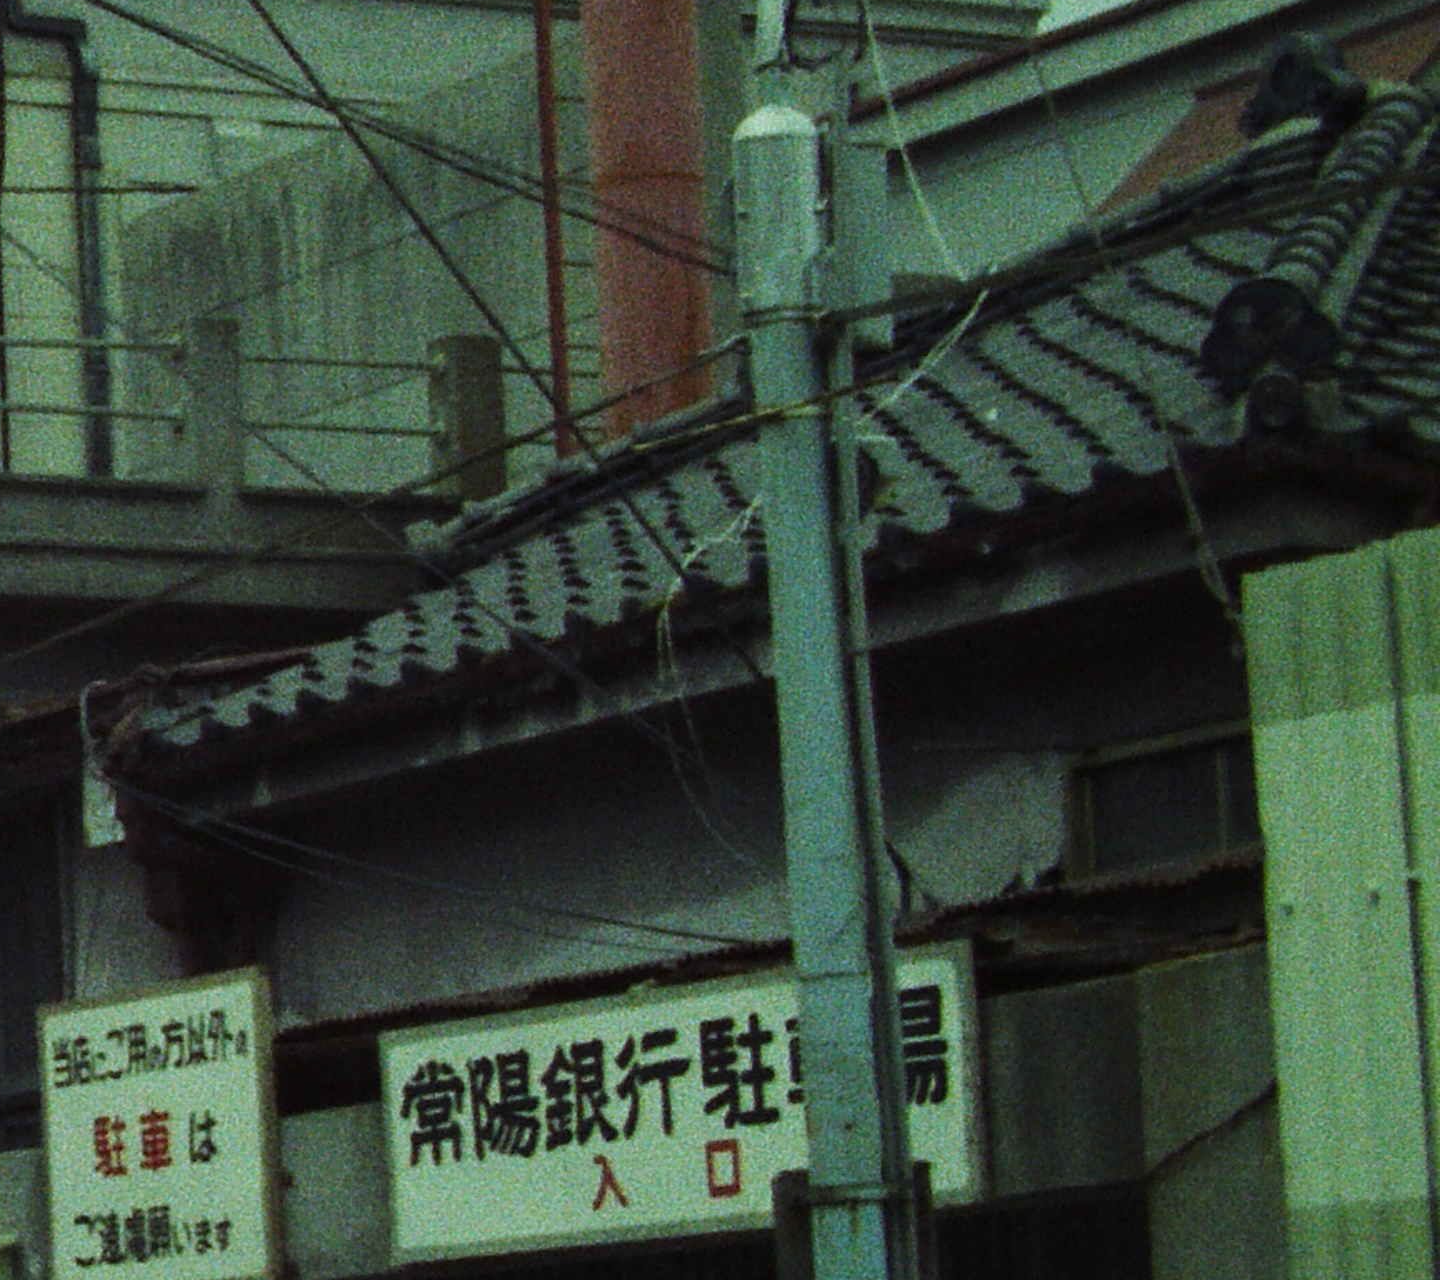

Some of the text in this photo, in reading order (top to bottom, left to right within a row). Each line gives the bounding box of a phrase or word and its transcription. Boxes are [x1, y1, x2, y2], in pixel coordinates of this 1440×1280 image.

[400, 983, 949, 1166] 常陽銀行駐場
[93, 1108, 218, 1178] 駐車は
